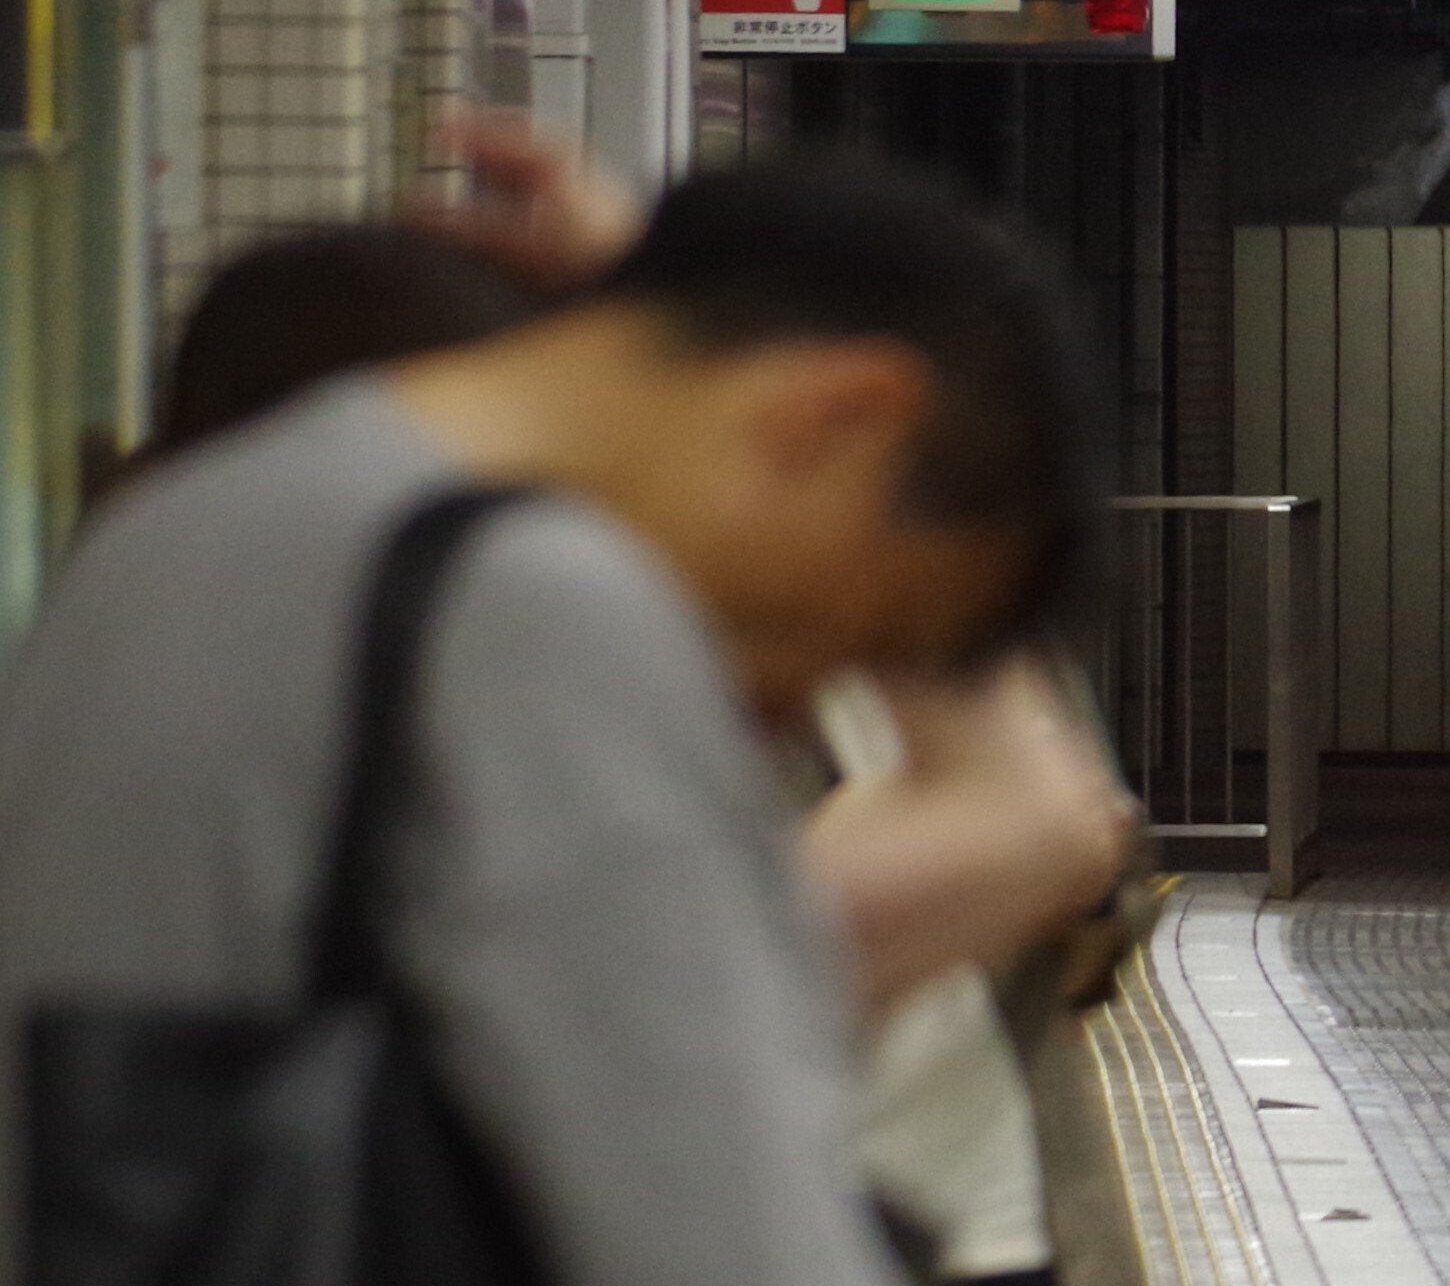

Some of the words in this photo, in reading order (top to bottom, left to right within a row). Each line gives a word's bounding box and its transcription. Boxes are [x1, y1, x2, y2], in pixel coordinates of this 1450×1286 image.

[733, 20, 838, 36] 非常停止ボタン
